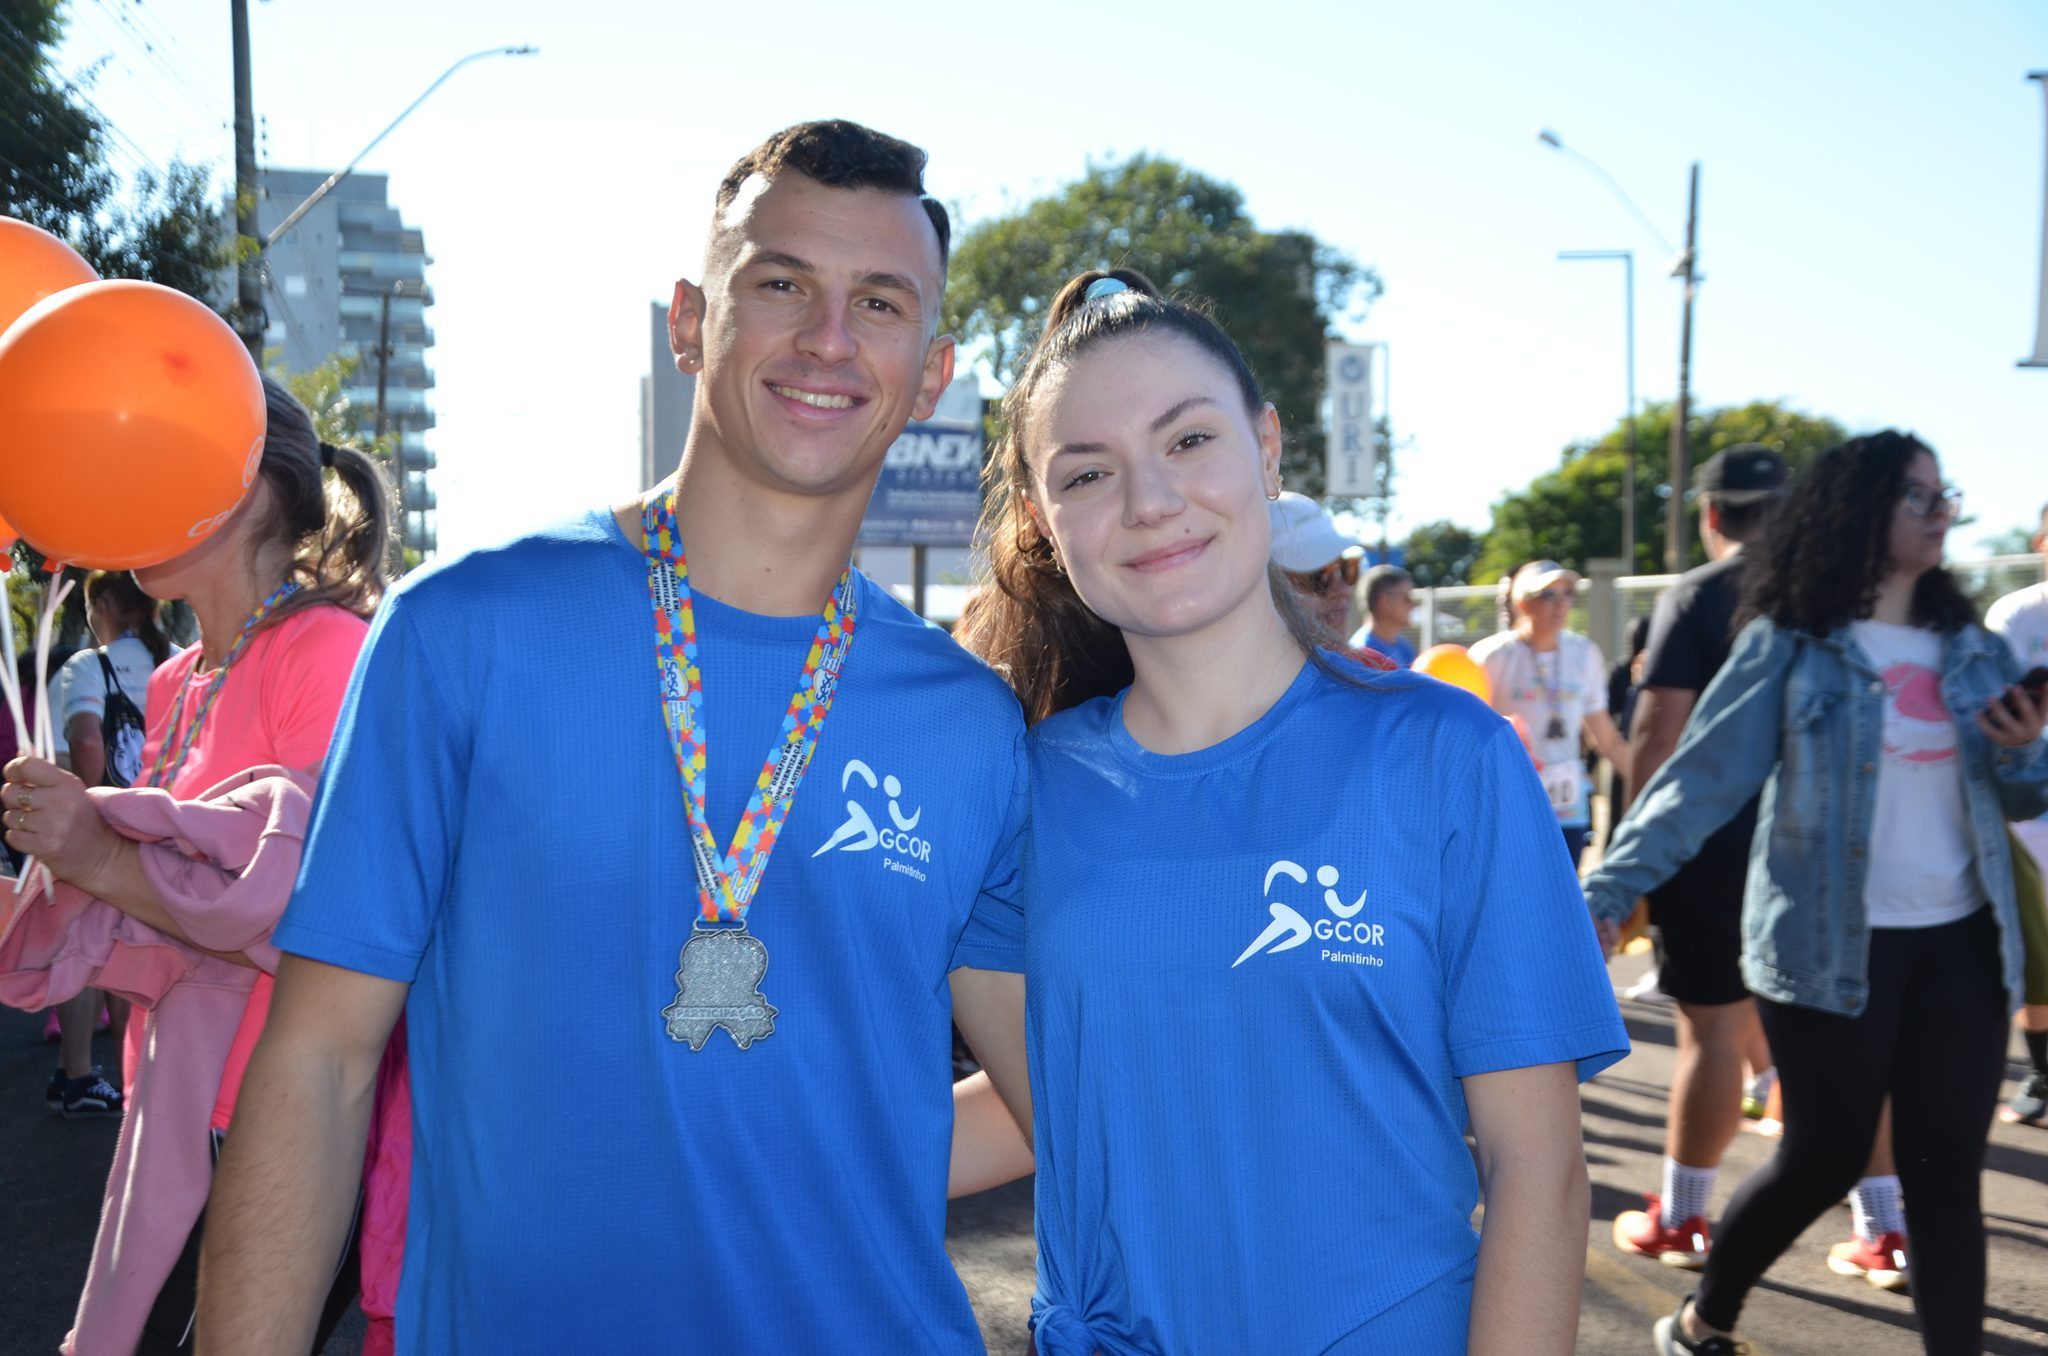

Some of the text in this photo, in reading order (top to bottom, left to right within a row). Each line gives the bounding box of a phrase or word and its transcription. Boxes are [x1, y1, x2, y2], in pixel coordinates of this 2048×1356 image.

[1340, 391, 1364, 484] URI
[771, 754, 788, 786] DESAFIO
[784, 742, 793, 754] EM
[772, 739, 804, 806] CONSCIENTIZAÇÃO
[785, 754, 807, 798] AO AUTISMO
[879, 827, 932, 863] GCOR
[883, 857, 927, 882] Palmitinho
[1314, 918, 1385, 946] GCOR
[1321, 949, 1385, 967] Palmitinho
[675, 1005, 766, 1020] PARTICIPAÇÃO
